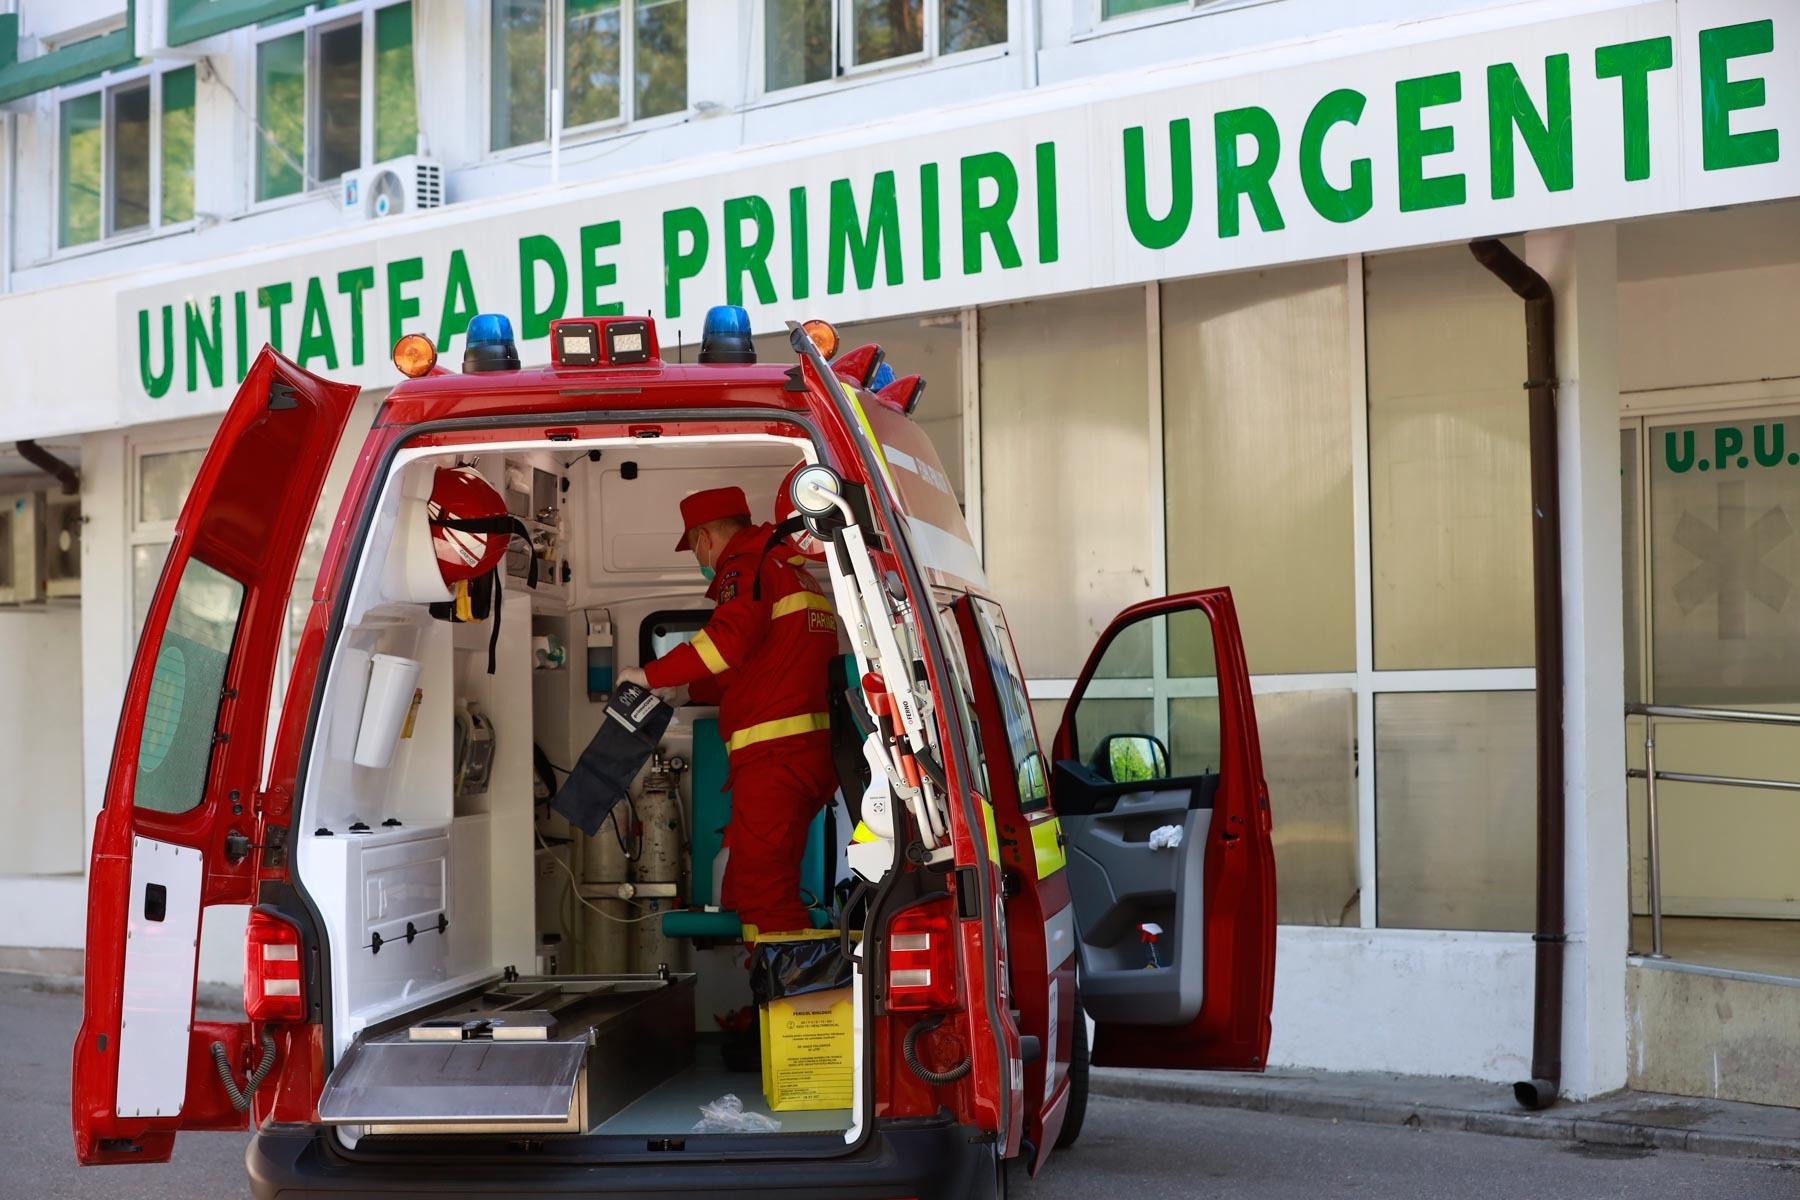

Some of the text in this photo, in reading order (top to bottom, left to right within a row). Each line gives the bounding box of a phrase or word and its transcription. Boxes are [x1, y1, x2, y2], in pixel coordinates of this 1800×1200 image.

[139, 19, 1780, 399] UNITATEA DE PRIMIRI URGENTE
[1665, 423, 1800, 473] U.P.U.
